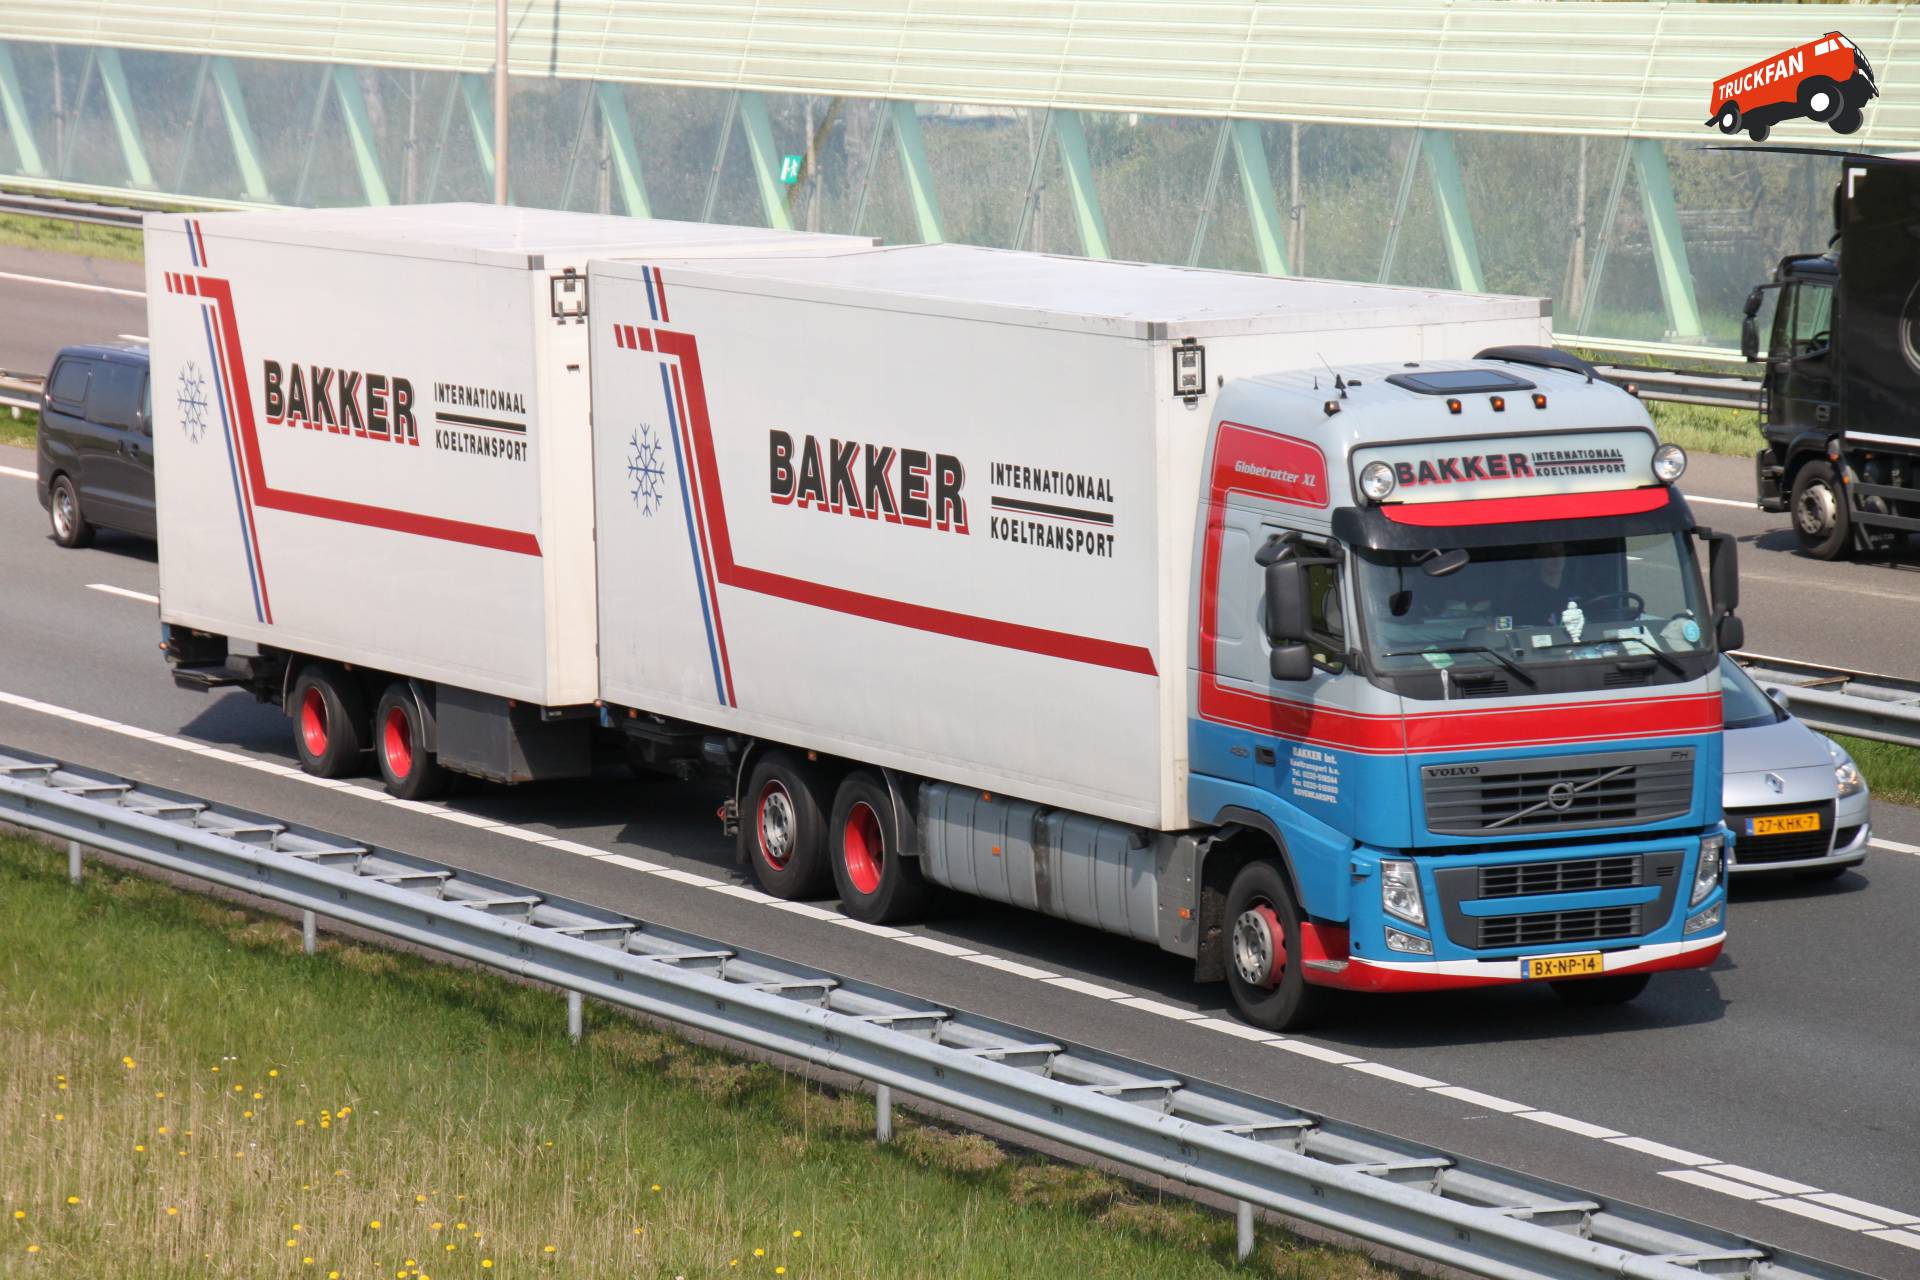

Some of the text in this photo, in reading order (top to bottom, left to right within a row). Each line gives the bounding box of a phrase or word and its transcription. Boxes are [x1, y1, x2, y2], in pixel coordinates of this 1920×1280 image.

[263, 359, 420, 446] BAKKER
[434, 382, 526, 414] INTERNATIONAAL
[435, 429, 527, 462] KOELTRANSPORT
[1532, 448, 1623, 461] INTERNATIONAAL
[769, 429, 970, 535] BAKKER
[991, 461, 1114, 503] INTERNATIONAAL
[1234, 460, 1316, 487] Globetrotter XL
[1395, 452, 1535, 487] BAKKER
[1535, 464, 1627, 477] KOELTRANSPORT
[991, 516, 1114, 558] KOELTRANSPORT
[1428, 766, 1480, 777] VOLVO
[1758, 815, 1815, 833] 27-KHK-7
[1535, 957, 1596, 976] BX-NP-14
